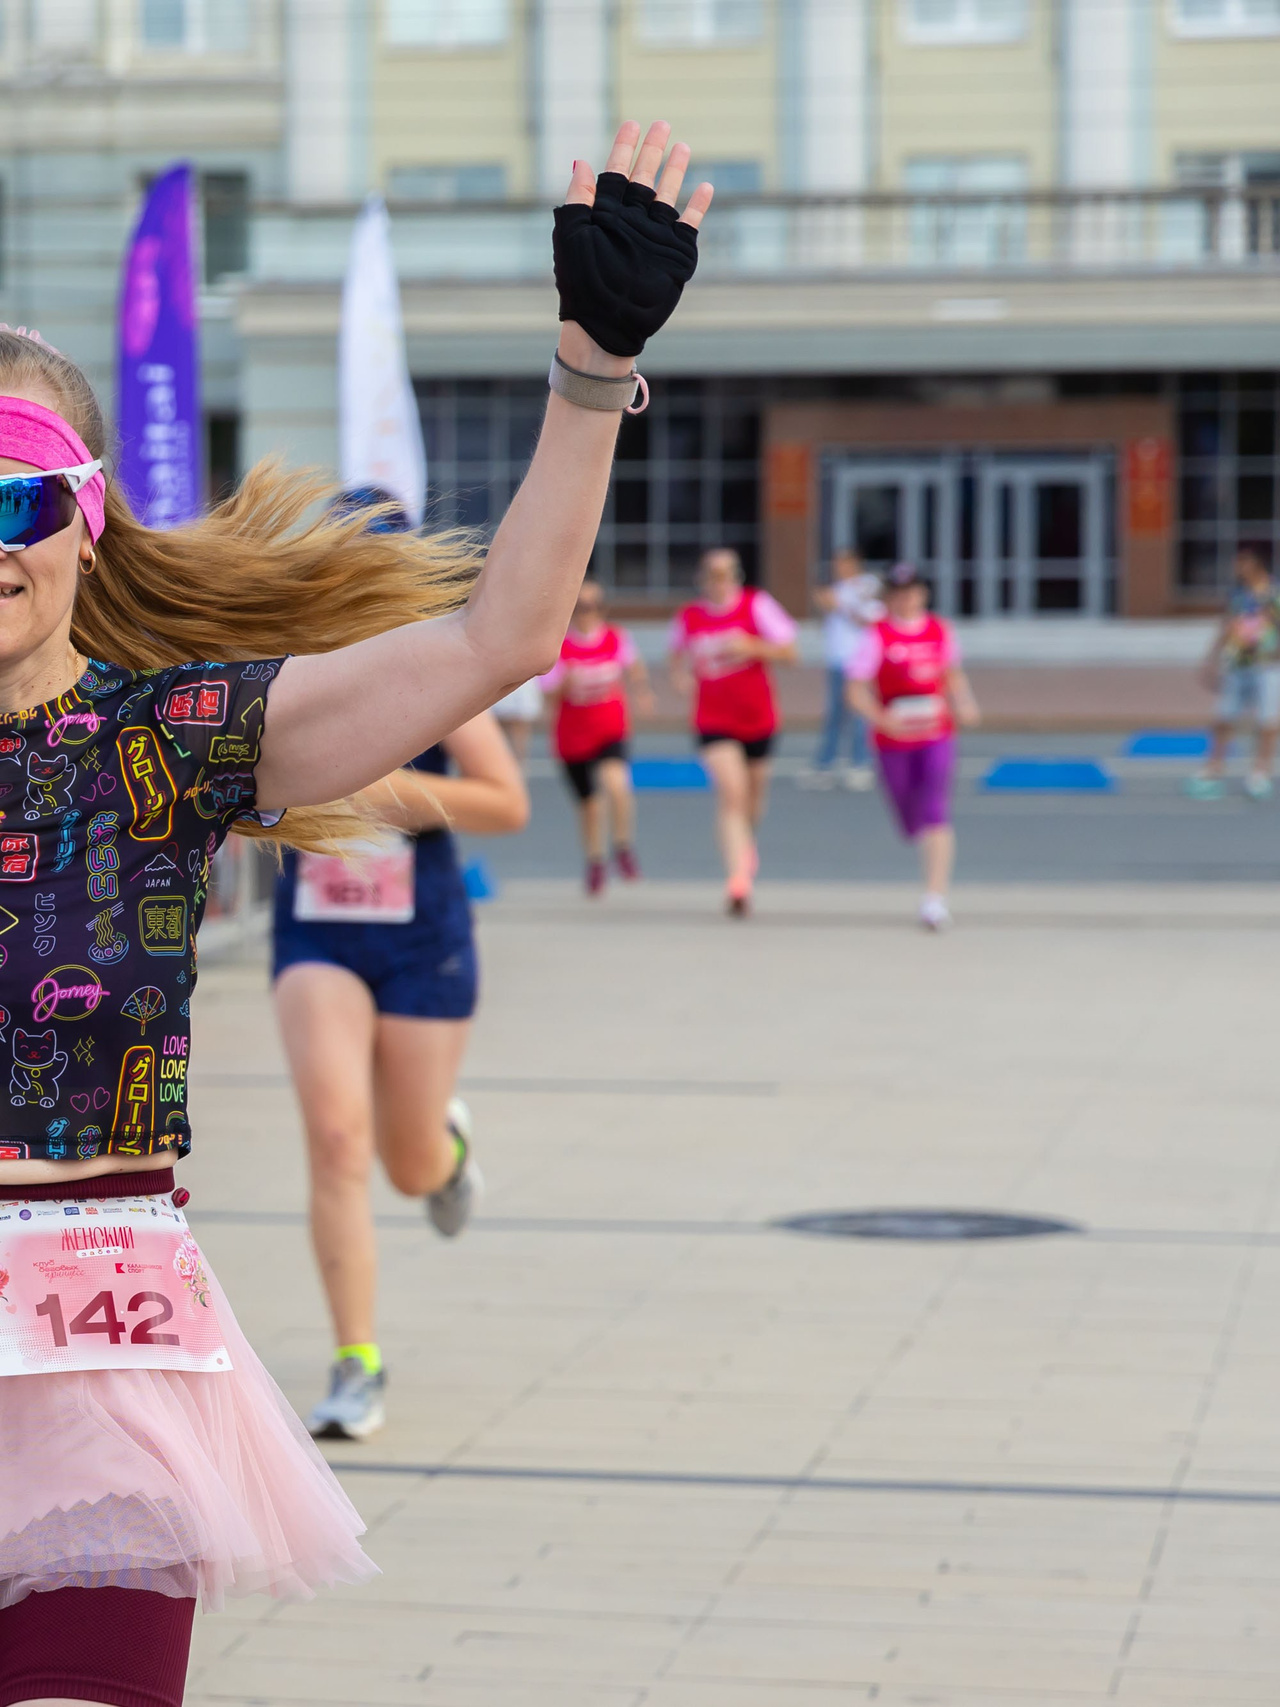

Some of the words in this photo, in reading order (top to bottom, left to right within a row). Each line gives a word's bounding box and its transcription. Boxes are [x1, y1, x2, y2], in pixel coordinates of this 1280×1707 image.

[145, 877, 171, 888] JAPAN
[163, 1035, 188, 1056] LOVE
[160, 1059, 186, 1080] LOVE
[159, 1083, 185, 1103] LOVE
[61, 1225, 135, 1251] ЖЕНСКИЙ
[35, 1291, 180, 1348] 142
